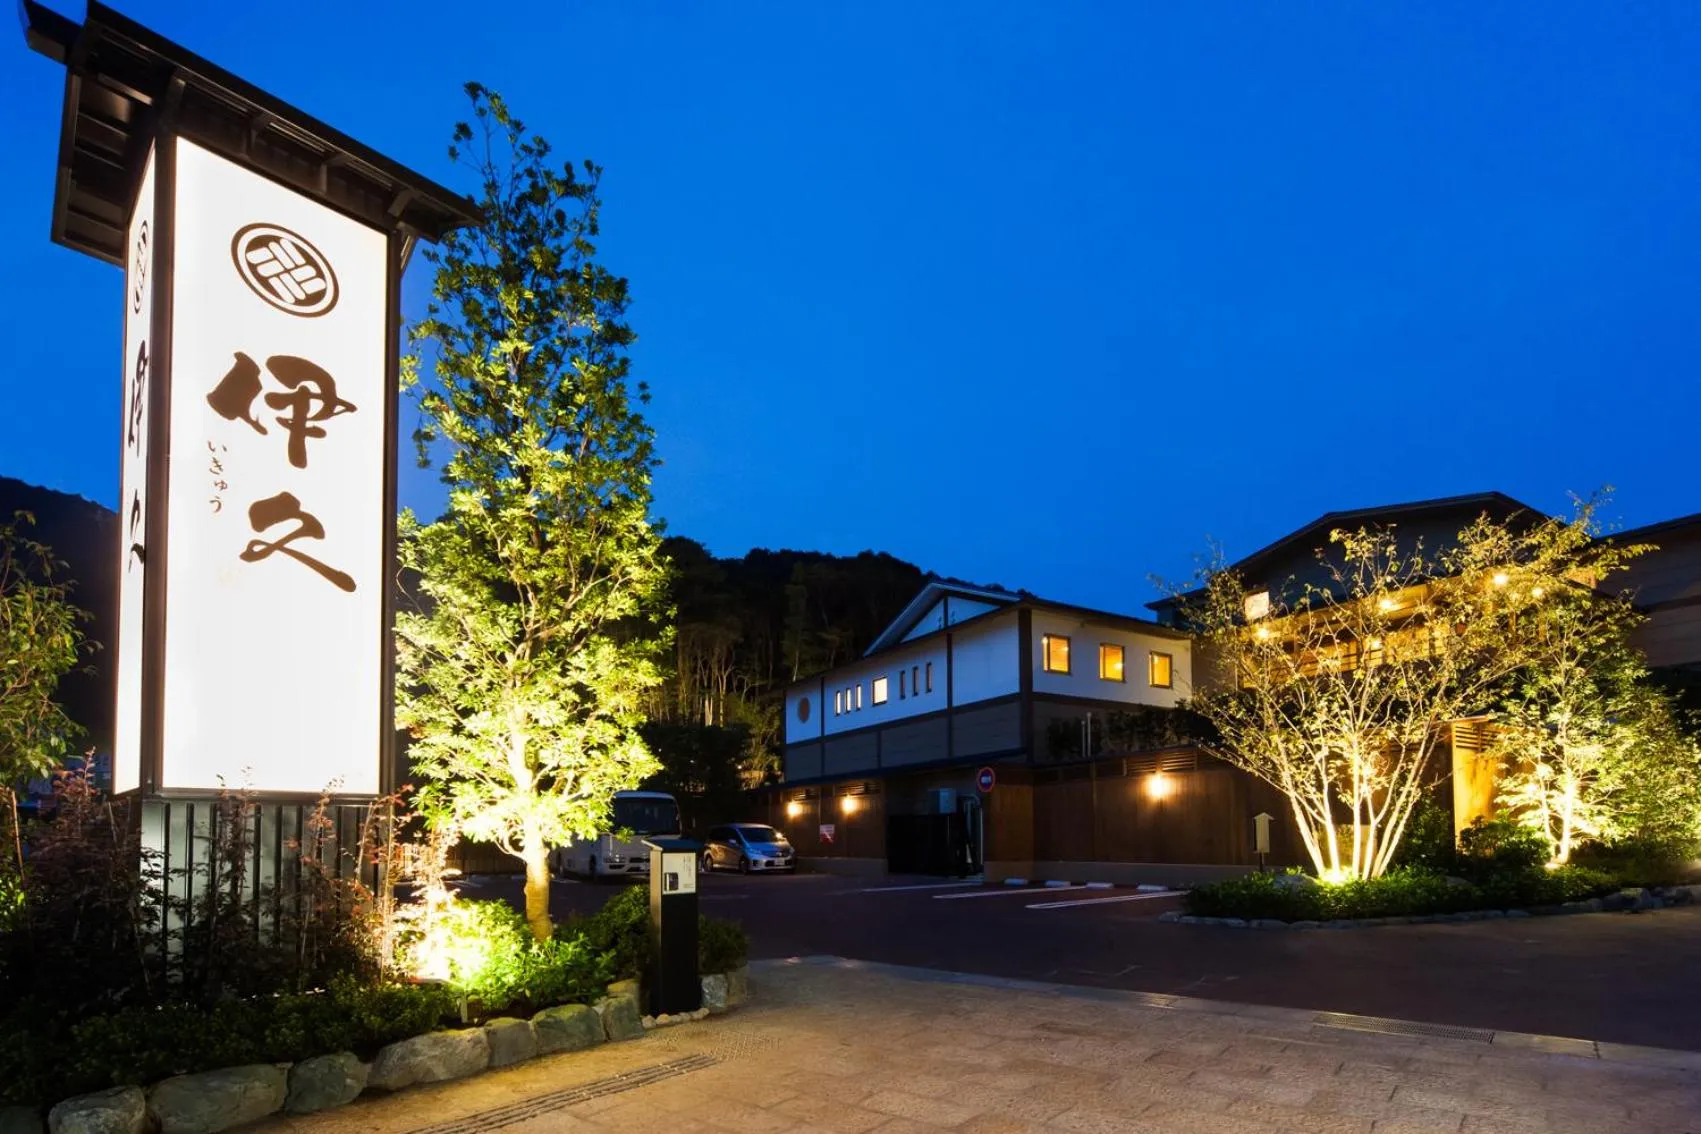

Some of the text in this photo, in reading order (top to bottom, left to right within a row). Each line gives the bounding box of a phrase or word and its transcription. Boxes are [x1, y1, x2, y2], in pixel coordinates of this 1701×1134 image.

[206, 351, 357, 593] 伊久
[207, 440, 228, 514] いきゅう
